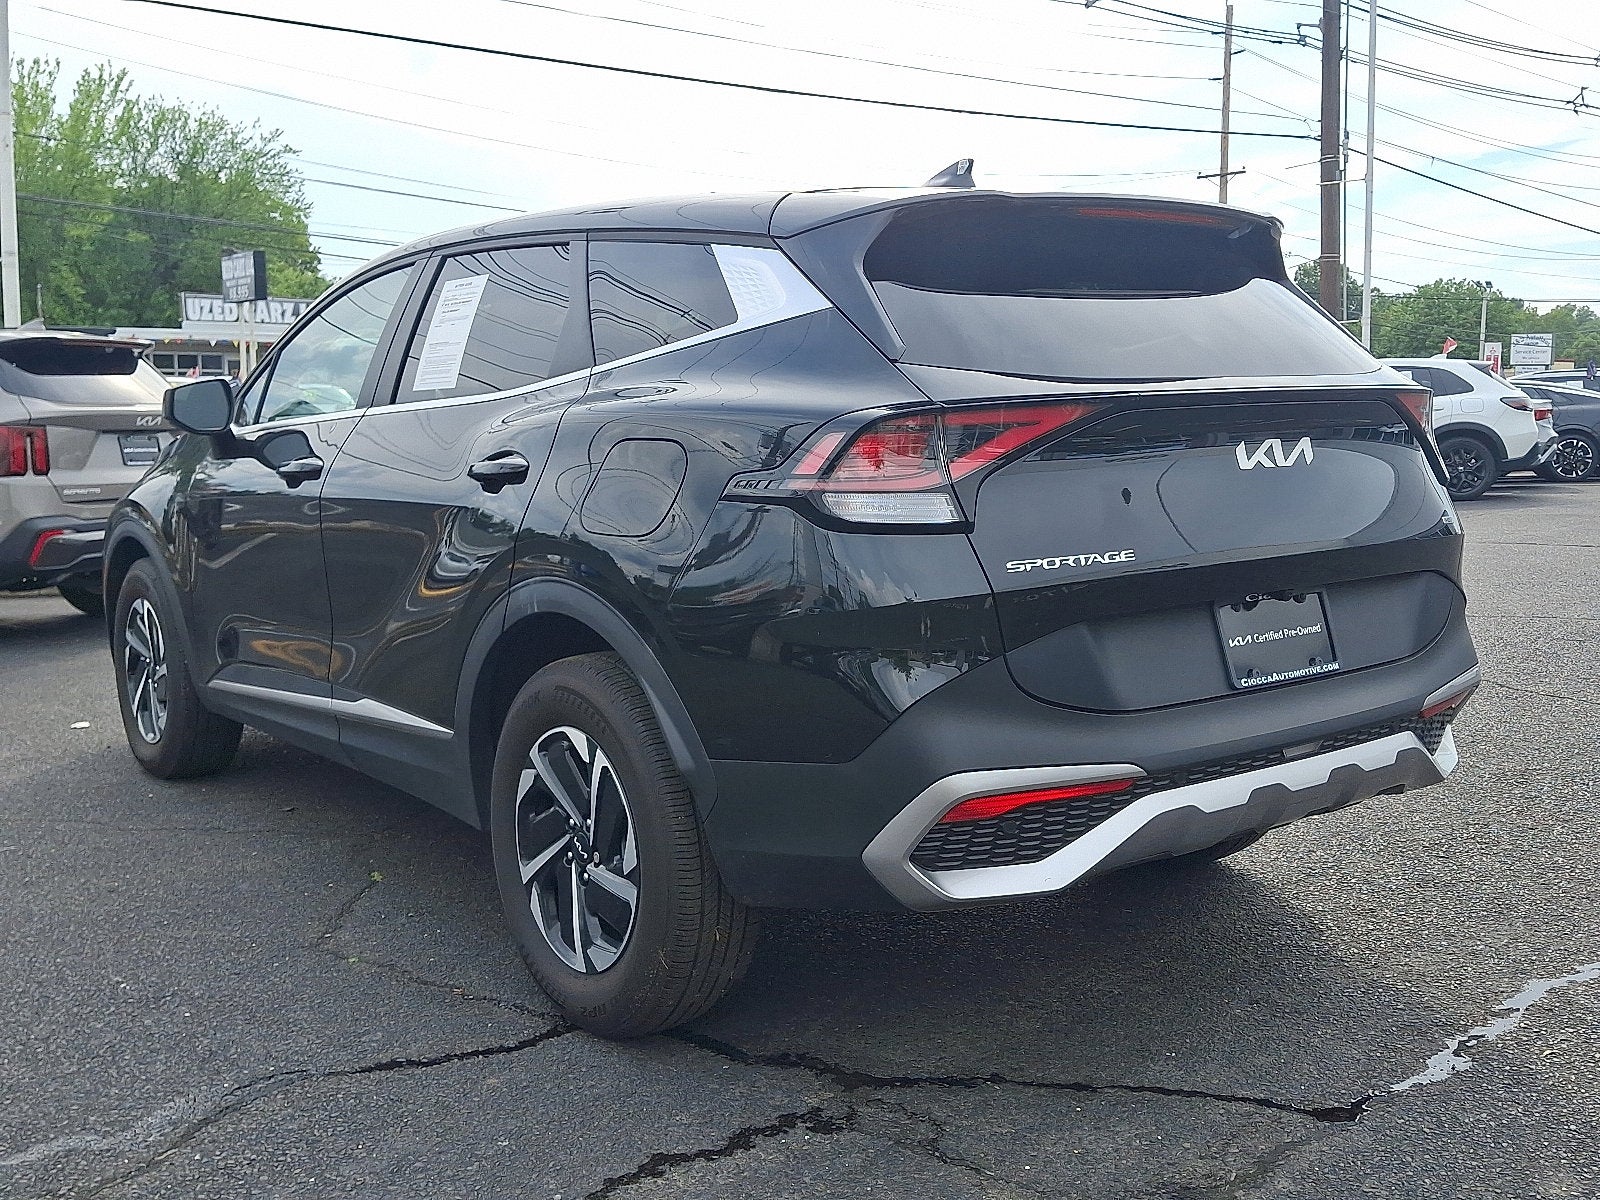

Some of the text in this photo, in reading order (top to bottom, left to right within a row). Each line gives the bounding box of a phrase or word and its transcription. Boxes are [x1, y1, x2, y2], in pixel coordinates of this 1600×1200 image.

[186, 297, 239, 321] UZED
[136, 416, 162, 426] KIA
[1235, 436, 1314, 470] KIA
[1006, 549, 1136, 573] SPORTAGE
[1253, 629, 1284, 643] Certified
